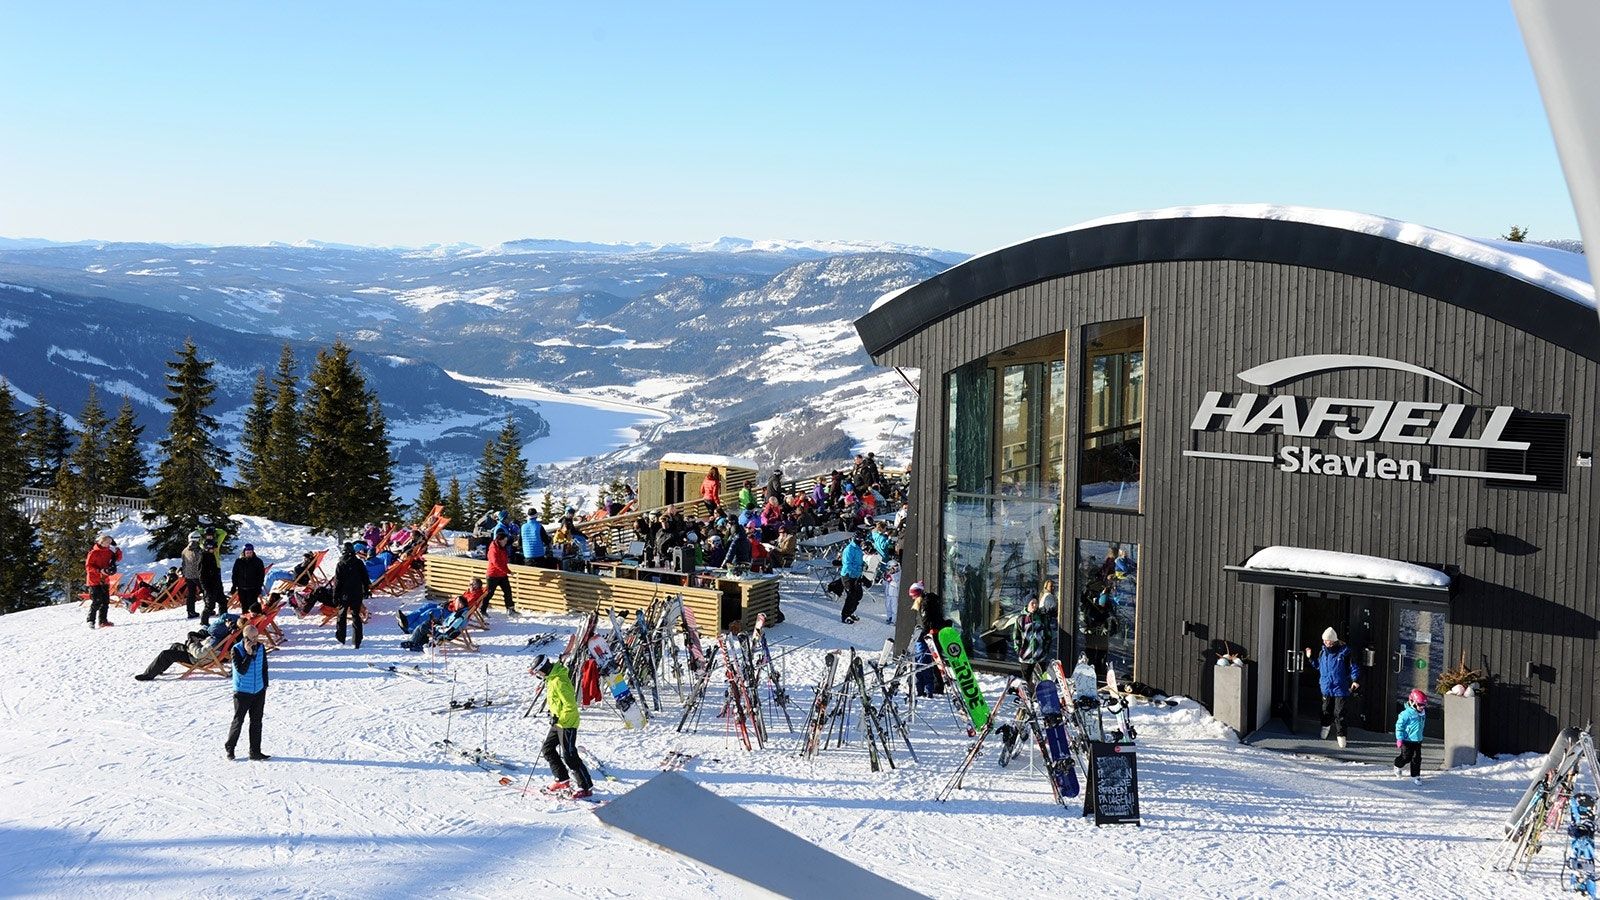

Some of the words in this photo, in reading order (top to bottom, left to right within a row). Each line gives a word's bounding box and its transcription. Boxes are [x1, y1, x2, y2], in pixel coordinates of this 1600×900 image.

[1190, 391, 1531, 451] HAFJELL
[1280, 446, 1422, 481] Skavlen
[955, 661, 985, 710] RIDE
